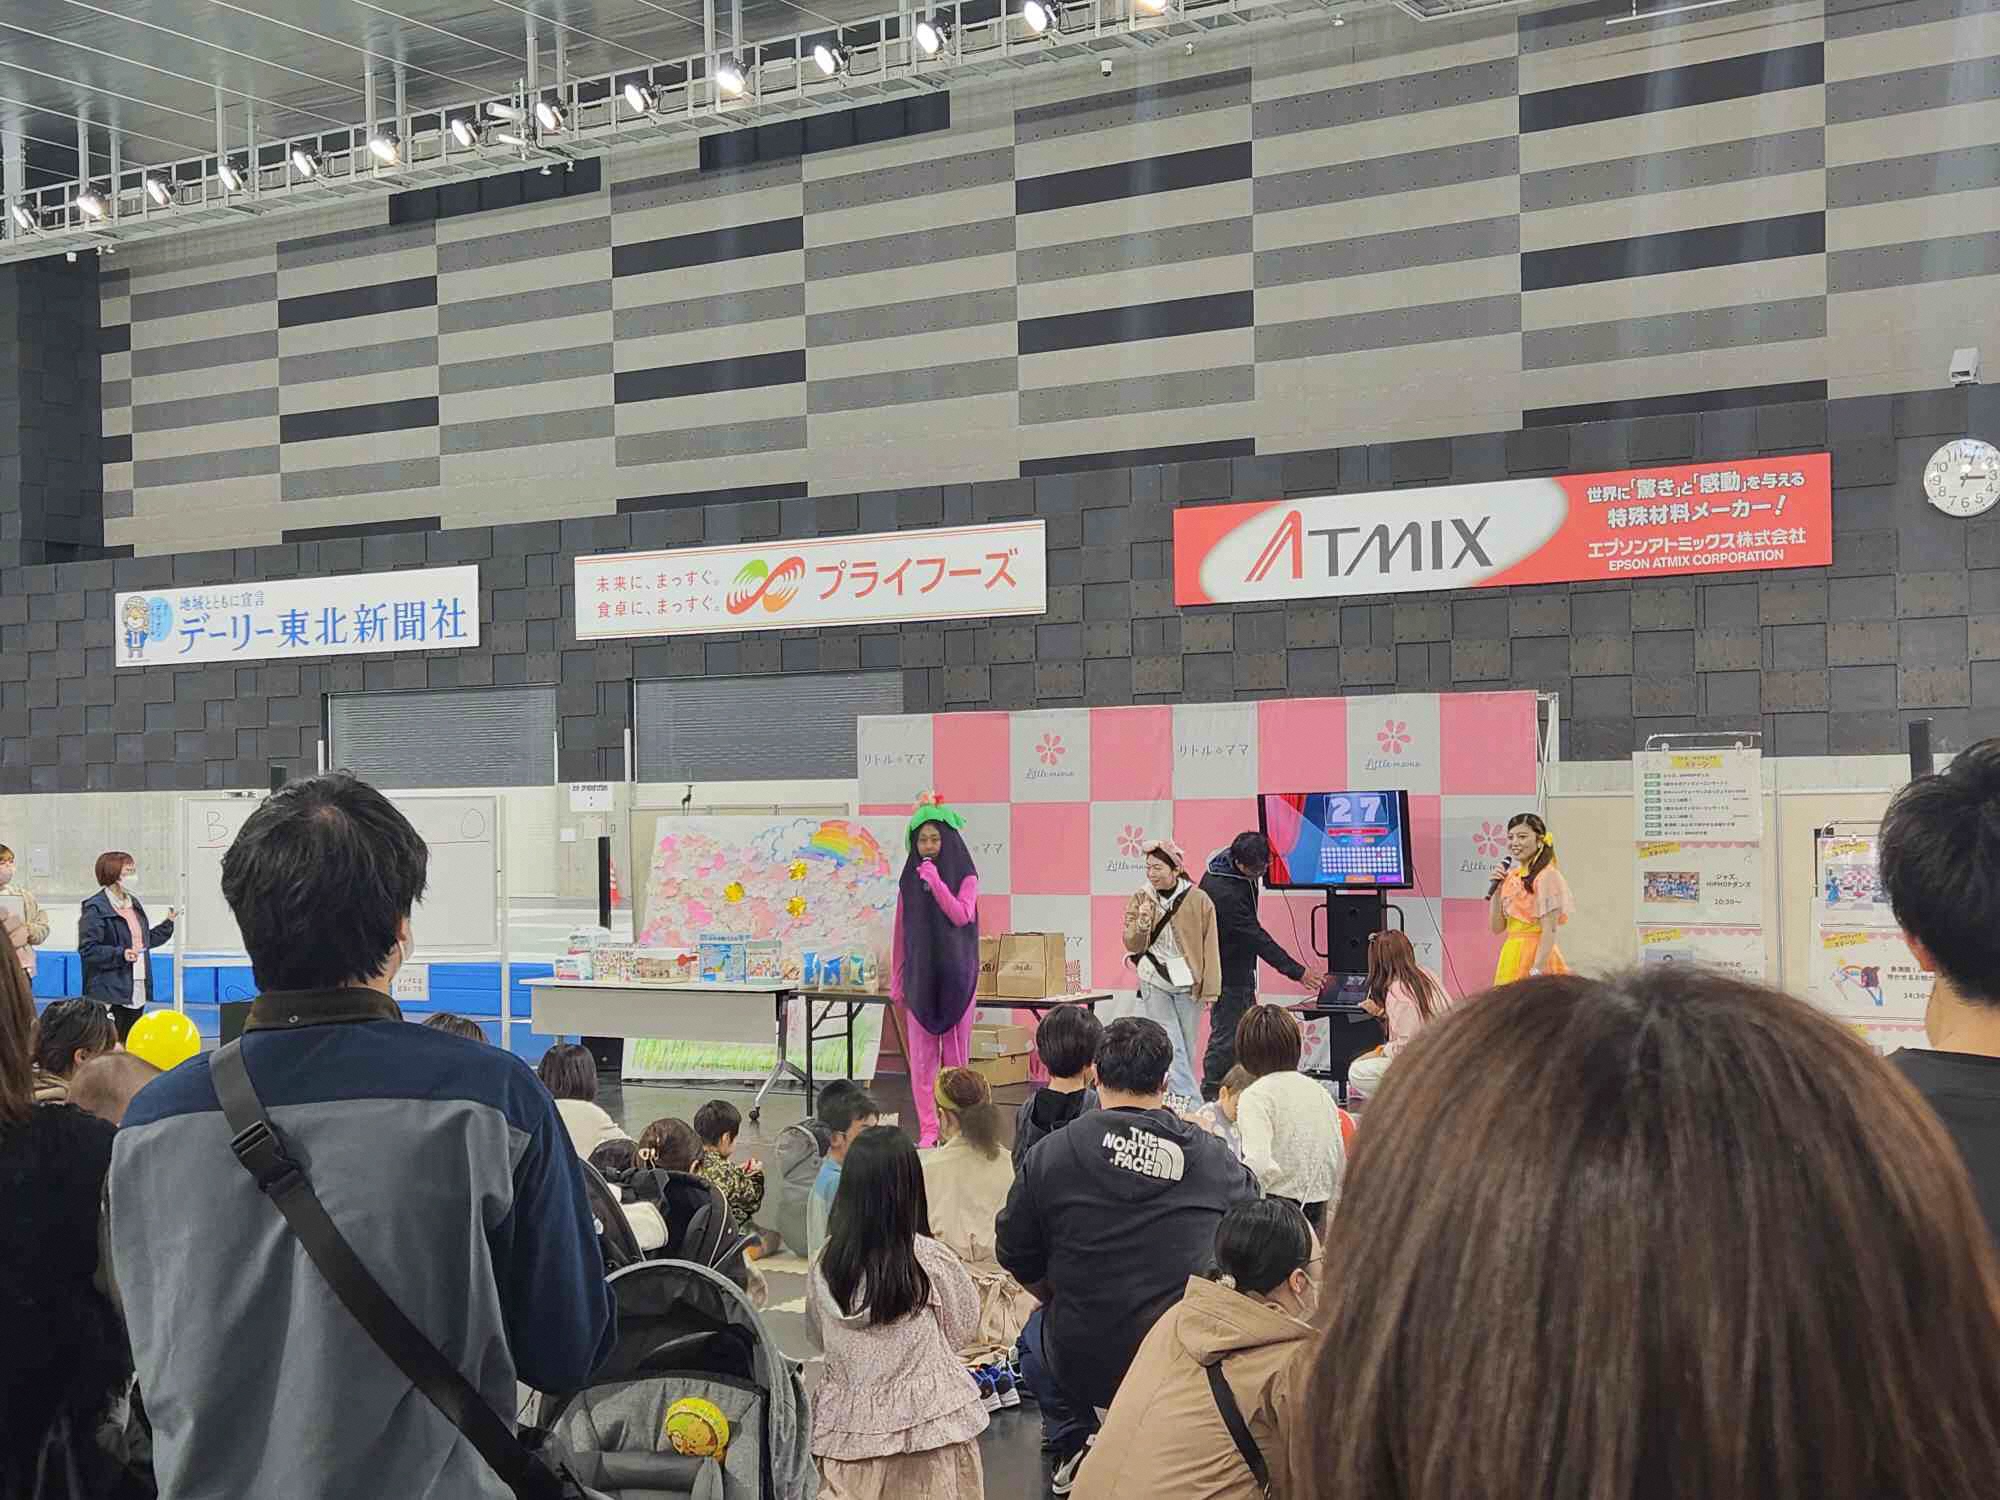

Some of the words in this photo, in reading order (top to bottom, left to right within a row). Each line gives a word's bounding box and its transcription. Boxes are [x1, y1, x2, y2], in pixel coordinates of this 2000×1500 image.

[1244, 510, 1493, 583] ATMIX
[1588, 527, 1807, 559] エプソンアトミックス株式会社
[816, 547, 1019, 600] プライフーズ
[1608, 558, 1650, 572] EPSON
[1653, 554, 1690, 568] ATMIX
[1693, 549, 1784, 565] CORPORATION
[595, 569, 720, 592] 未来に、まっすぐ。
[597, 595, 721, 618] 食卓に、まっすぐ。
[178, 597, 467, 654] デーリー東北新聞社
[1330, 797, 1381, 823] 27
[1102, 1132, 1158, 1161] NORTH
[1129, 1126, 1159, 1148] THE
[1113, 1153, 1154, 1177] FACE
